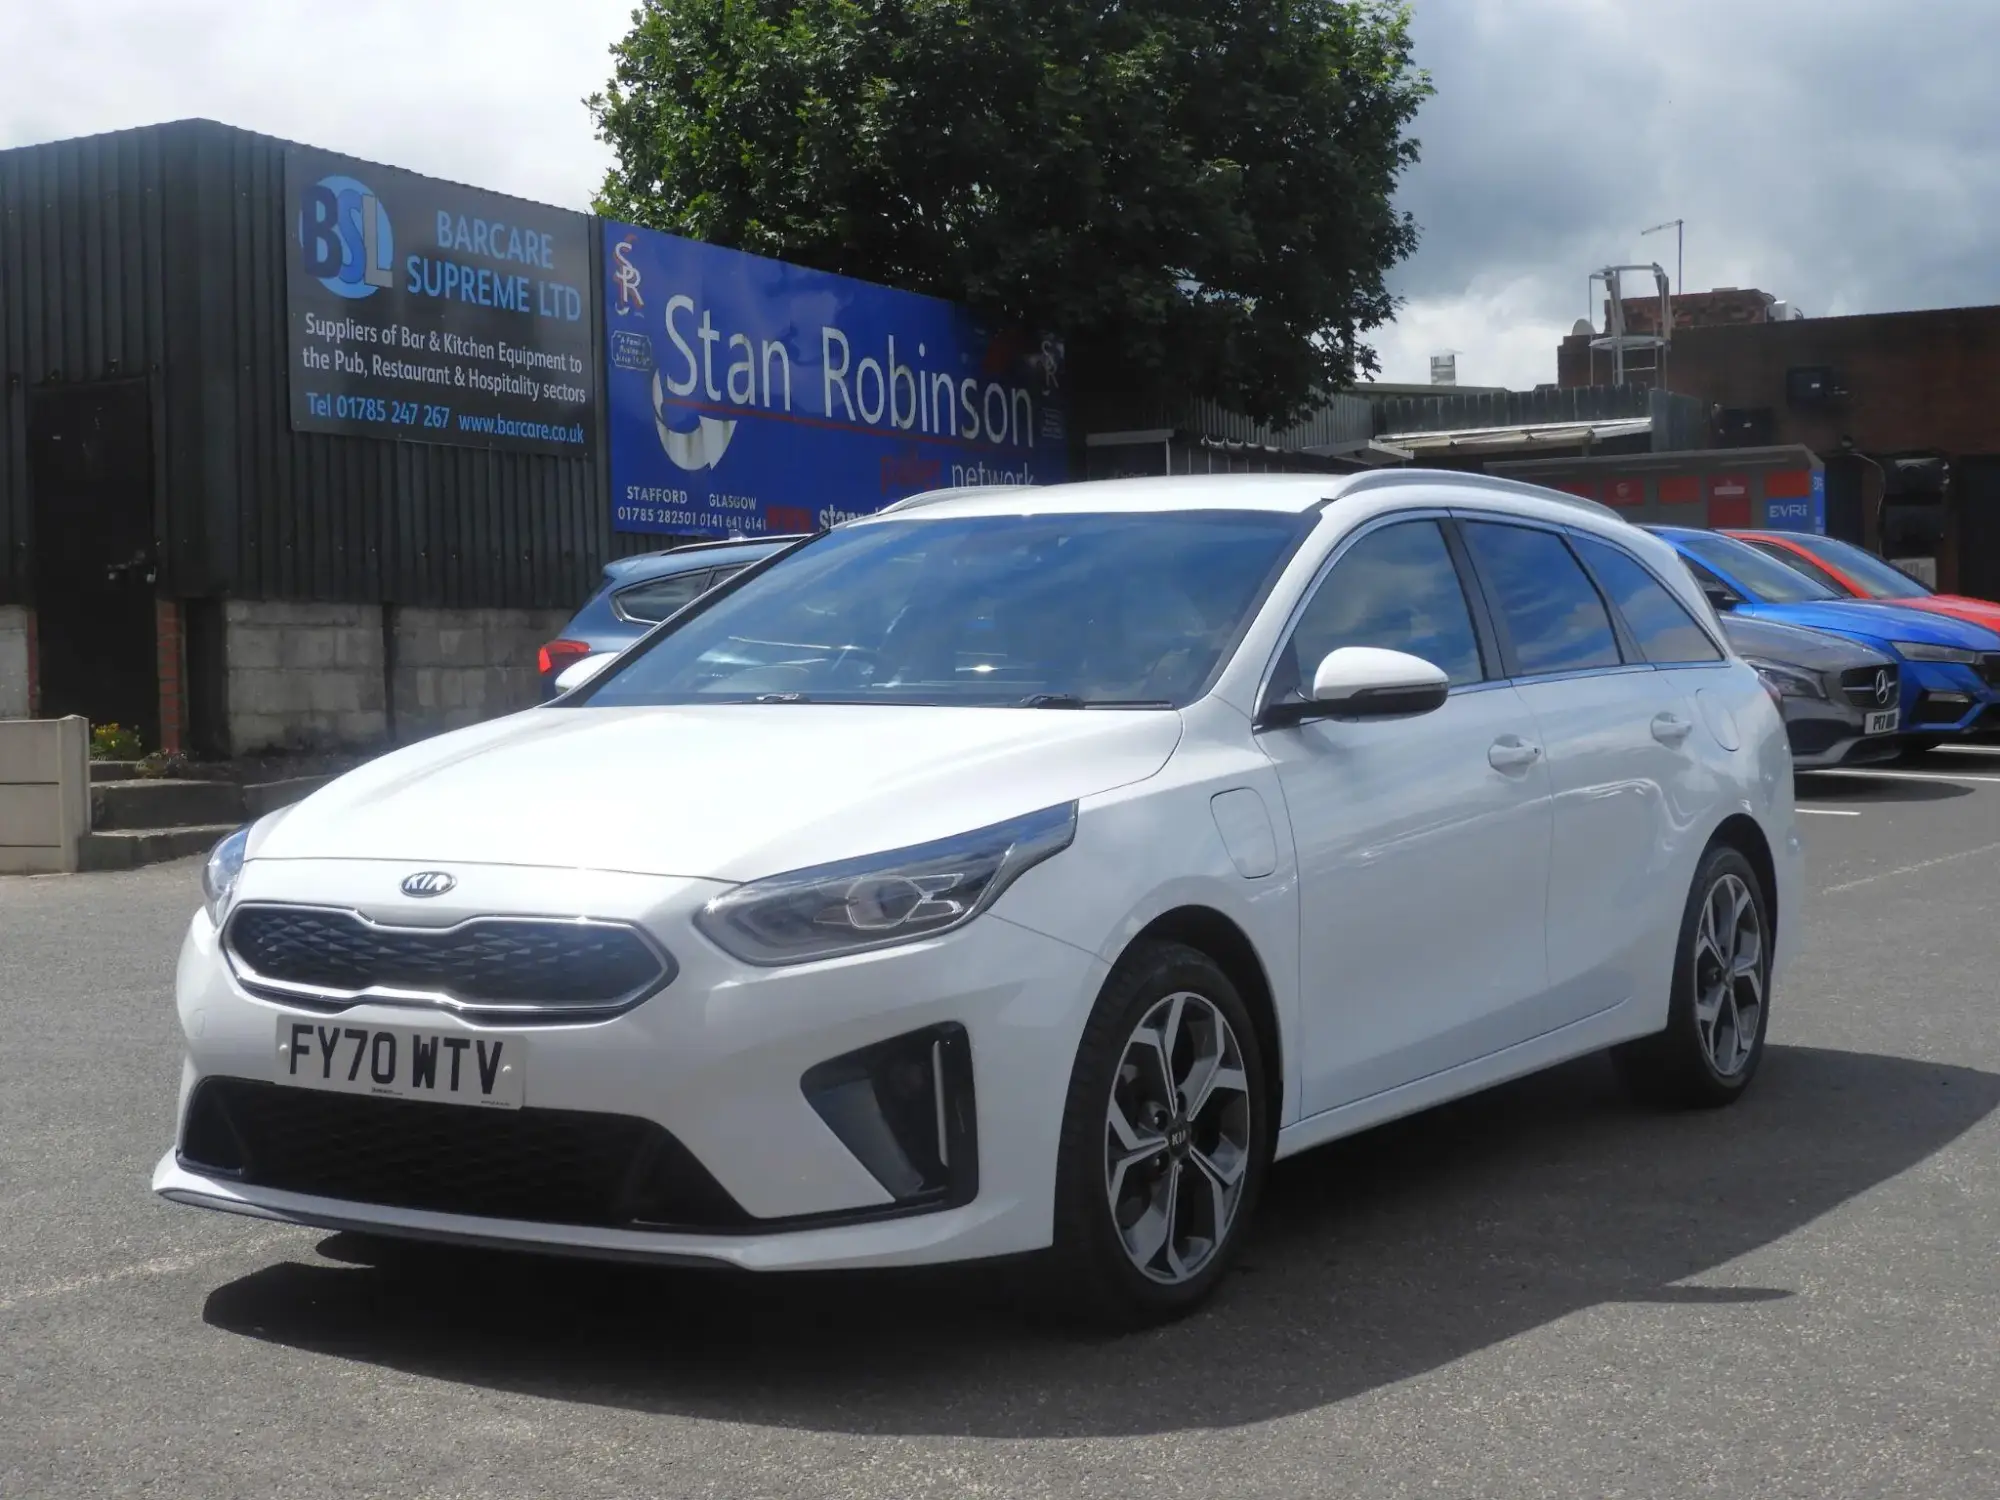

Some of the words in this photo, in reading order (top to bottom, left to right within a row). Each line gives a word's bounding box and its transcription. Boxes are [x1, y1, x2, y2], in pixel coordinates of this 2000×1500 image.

[302, 186, 393, 288] BSL
[437, 210, 555, 269] BARCARE
[406, 255, 530, 313] SUPREME
[539, 282, 582, 321] LTD
[305, 313, 377, 343] Suppliers
[382, 324, 398, 345] of
[402, 328, 425, 349] Bar
[429, 332, 441, 352] &
[444, 333, 495, 360] Kitchen
[498, 342, 566, 372] Equipment
[569, 355, 583, 374] to
[303, 347, 329, 370] the
[335, 350, 368, 378] Pub,
[372, 354, 451, 385] Restaurant
[454, 367, 466, 386] &
[468, 367, 540, 402] Hospitality
[543, 381, 587, 404] sectors
[665, 295, 791, 411] Stan
[822, 326, 1035, 448] Robinson
[307, 392, 331, 416] Tel
[337, 394, 386, 422] 01785
[391, 402, 417, 425] 247
[423, 405, 450, 429] 267
[459, 413, 584, 444] www.barcare.co.uk
[627, 486, 688, 505] STAFFORD
[952, 461, 1034, 487] network
[618, 506, 654, 522] 01785
[657, 509, 696, 525] 282501
[700, 513, 722, 529] 0141
[726, 516, 742, 529] 641
[745, 517, 766, 531] 6141
[709, 493, 757, 511] GLASGOW
[404, 873, 449, 891] KIA
[289, 1023, 397, 1085] FY70
[412, 1034, 504, 1096] WTV
